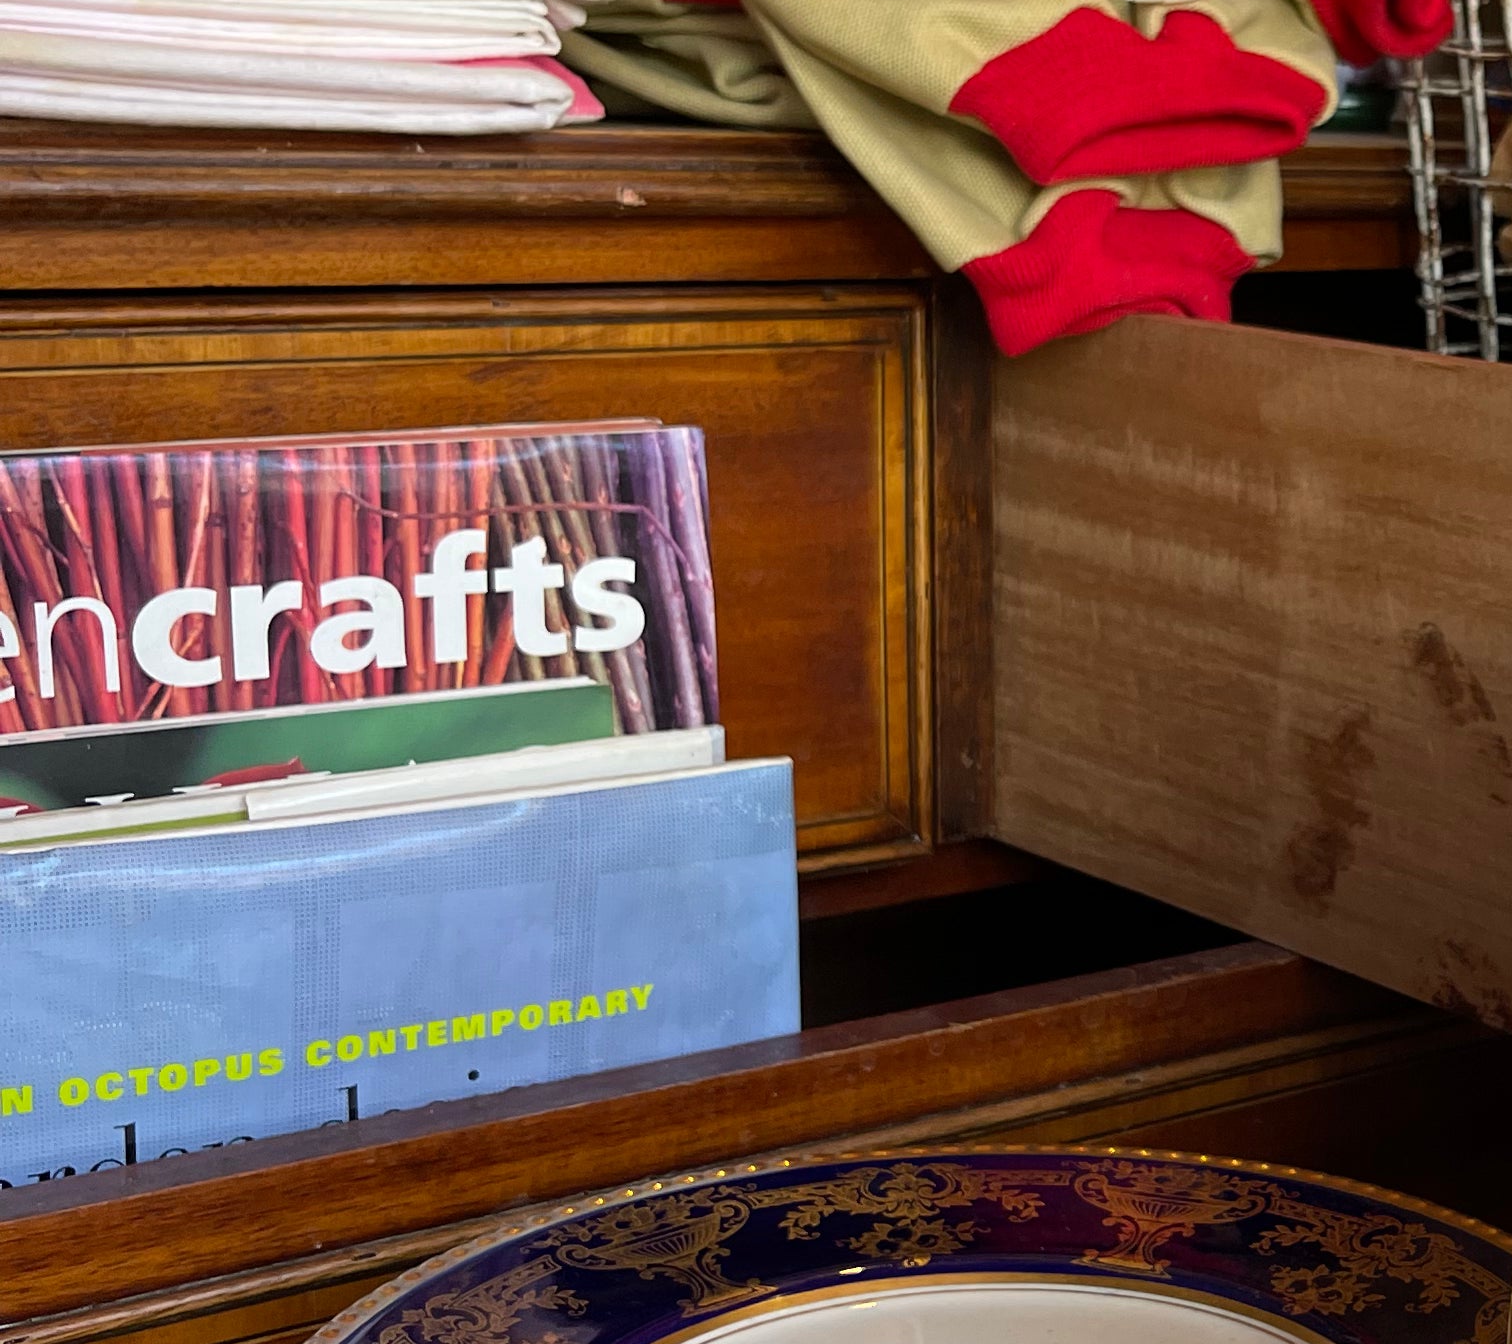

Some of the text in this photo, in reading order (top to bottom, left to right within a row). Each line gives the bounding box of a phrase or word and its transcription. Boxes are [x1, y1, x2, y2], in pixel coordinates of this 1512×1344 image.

[0, 528, 646, 703] ncrafts
[58, 1048, 285, 1107] OCTOPUS
[306, 983, 655, 1067] CONTEMPORARY
